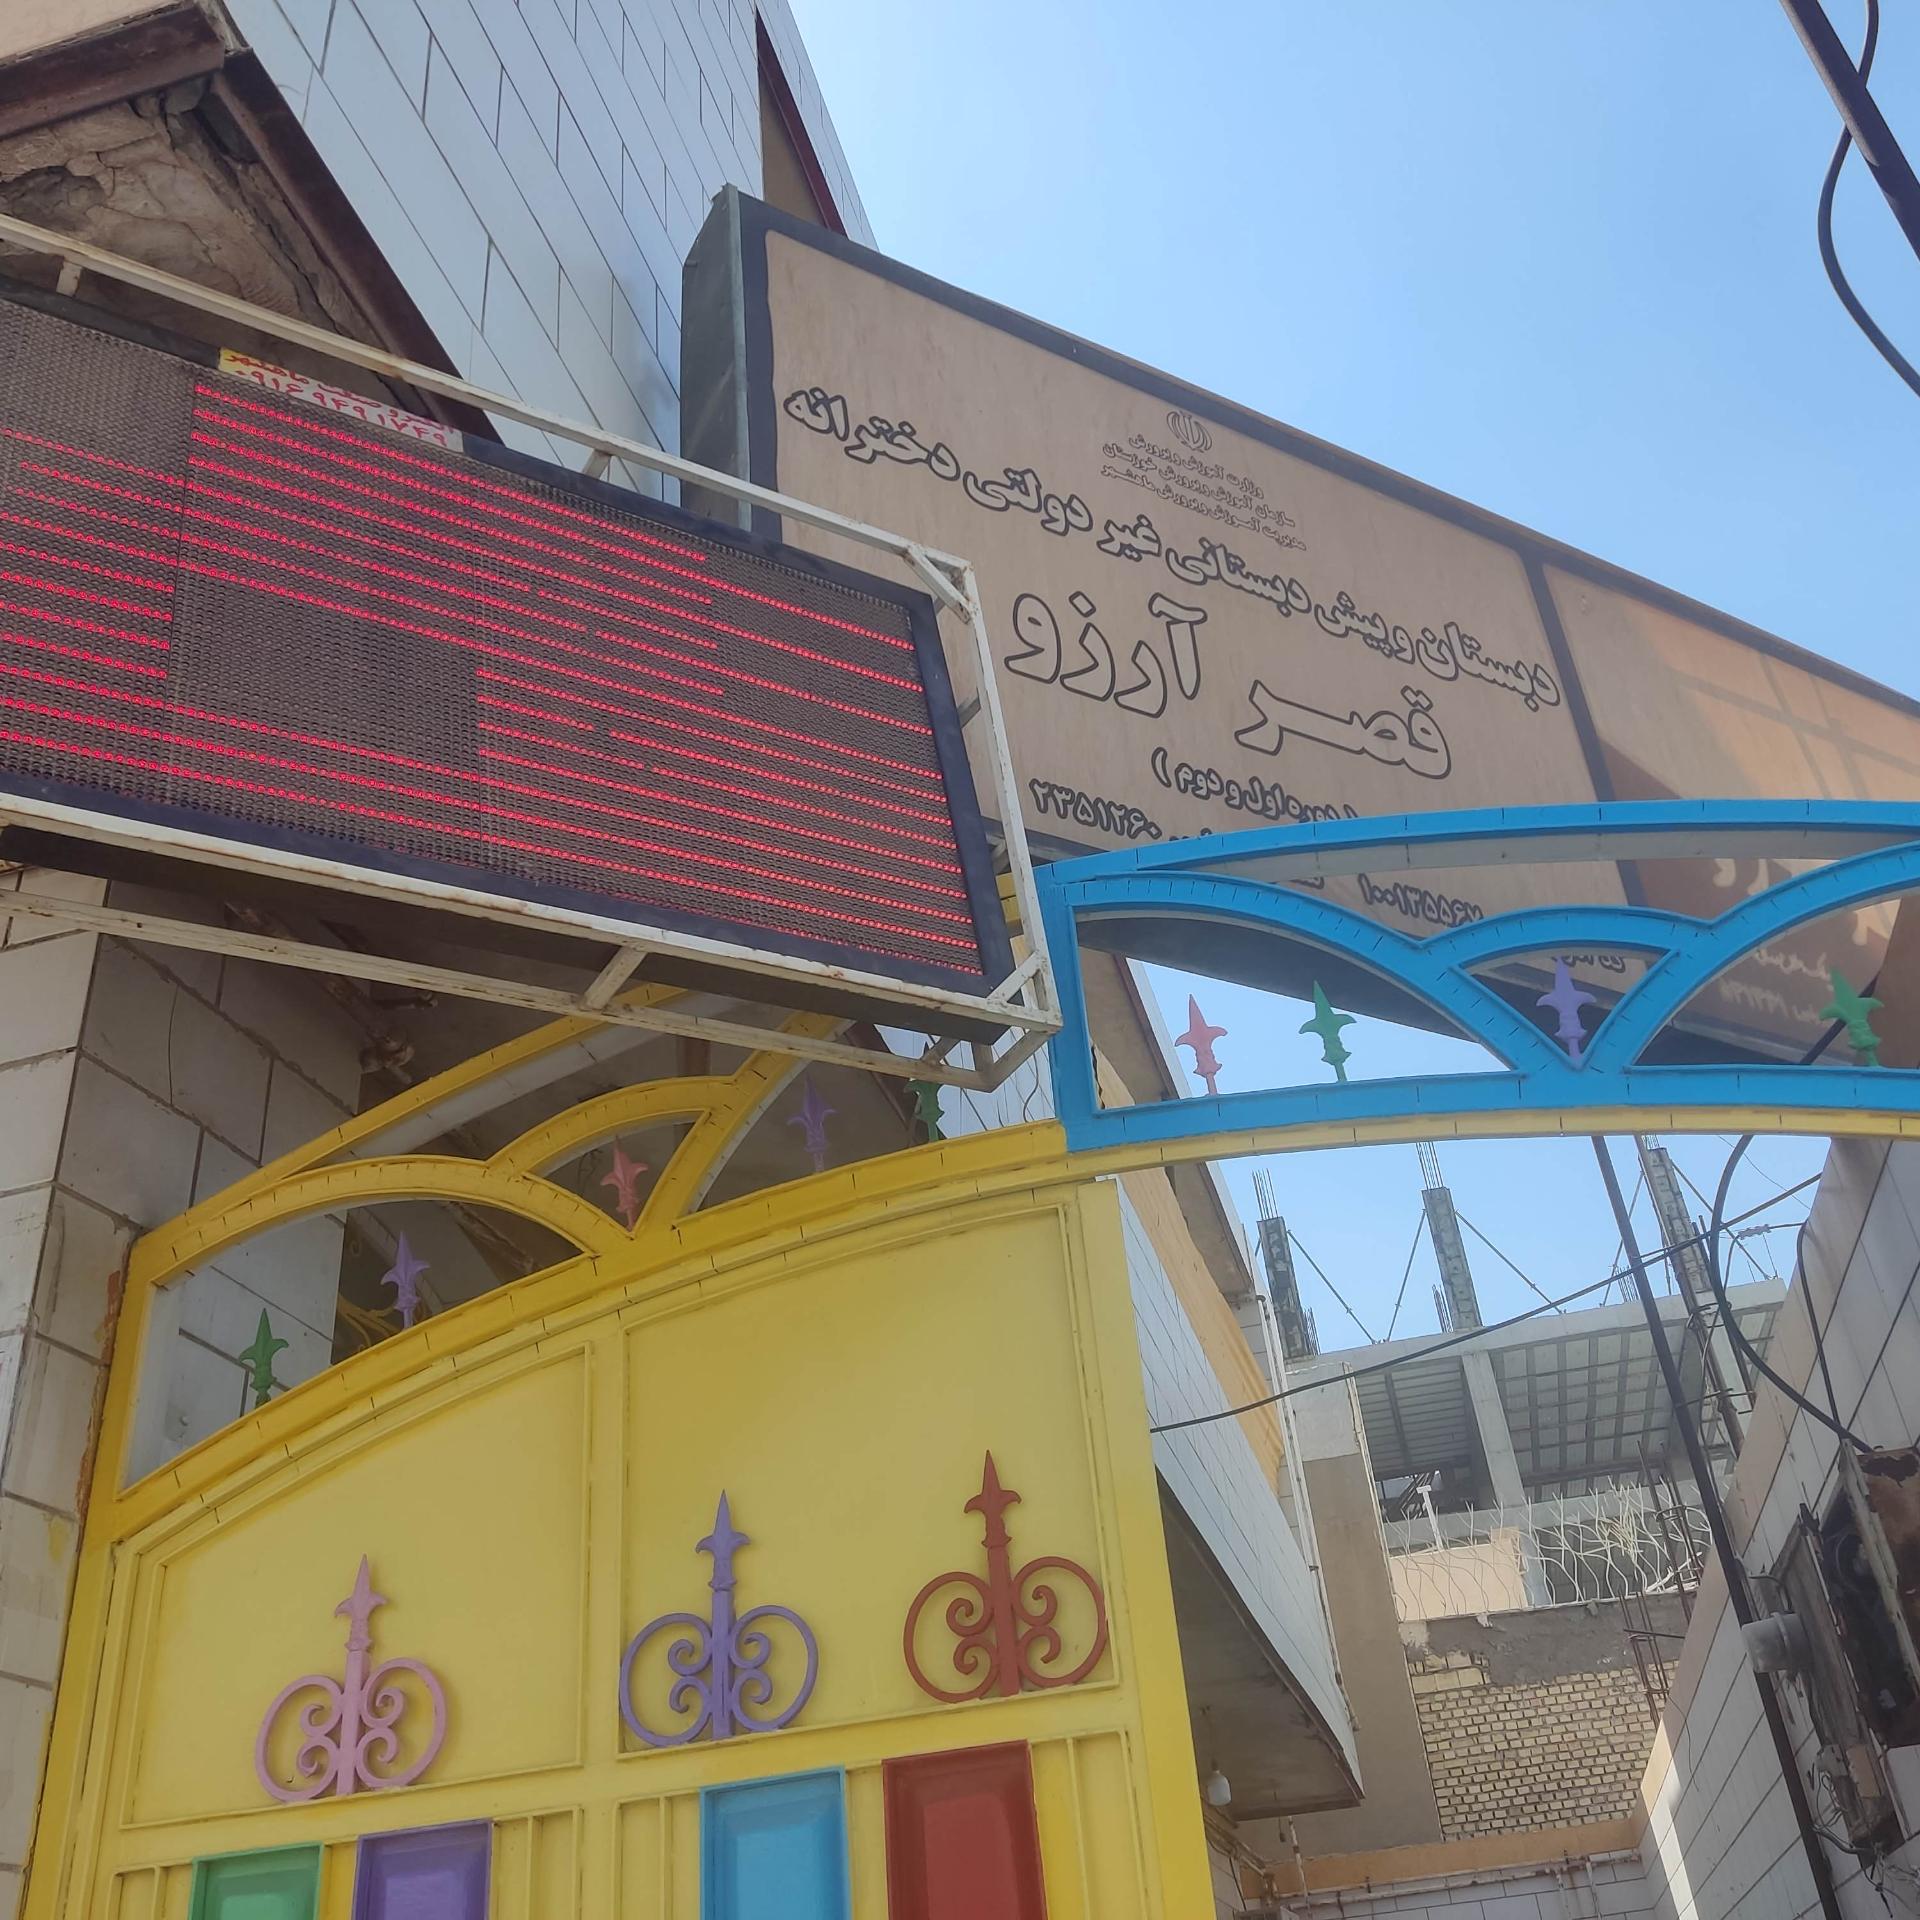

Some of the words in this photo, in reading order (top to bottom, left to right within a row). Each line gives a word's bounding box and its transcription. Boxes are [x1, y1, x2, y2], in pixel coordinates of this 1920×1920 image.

[783, 386, 961, 482] دخترانه
[1181, 455, 1225, 480] آموزش
[963, 468, 1094, 536] دولتی
[1208, 505, 1261, 532] آموزش
[1210, 485, 1253, 510] آموزش
[1096, 514, 1162, 561] غیر
[1165, 537, 1312, 617] دبستانی
[1004, 590, 1208, 718] آرزو
[1314, 591, 1393, 658] پیش
[1391, 624, 1416, 664] و
[1415, 621, 1561, 712] دبستان
[1234, 679, 1452, 779] قصر
[1245, 775, 1286, 820] اول
